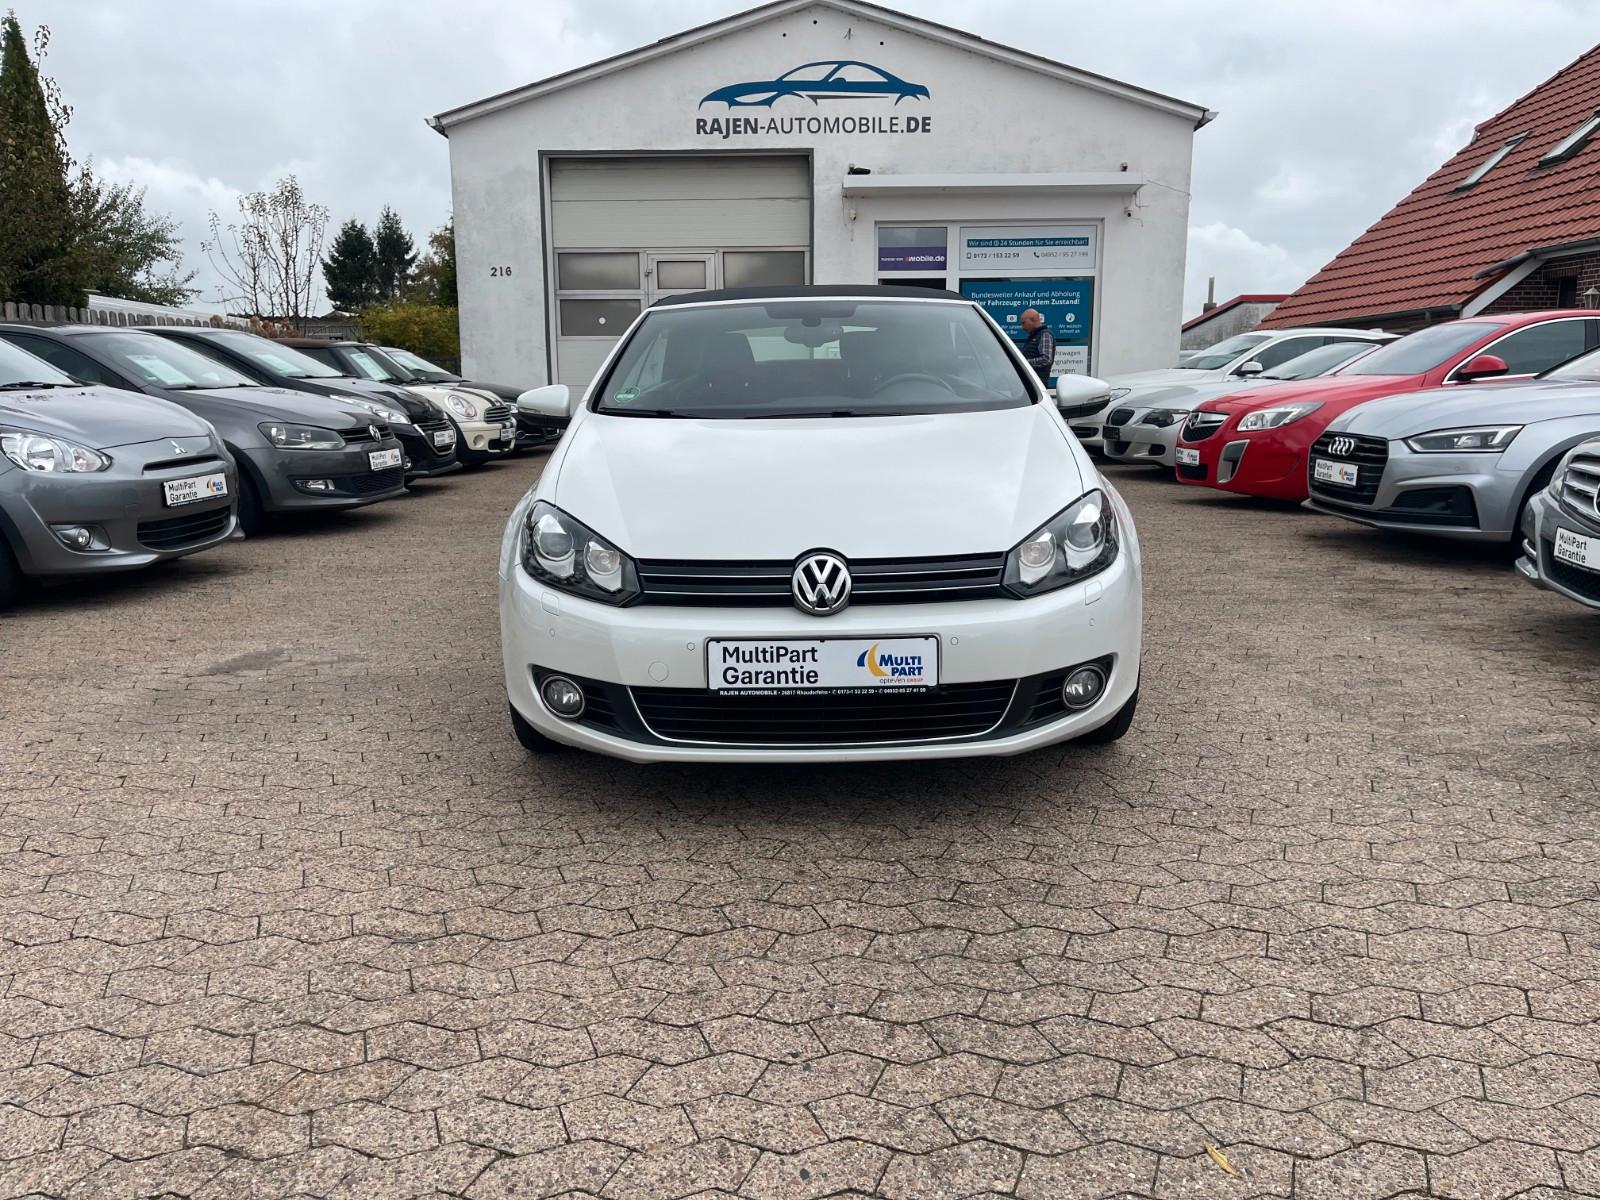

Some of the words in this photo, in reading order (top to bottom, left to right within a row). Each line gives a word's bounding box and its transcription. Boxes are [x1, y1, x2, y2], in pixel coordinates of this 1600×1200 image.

[696, 116, 931, 139] RAJEN-AUTOMOBILE.DE
[490, 266, 512, 277] 216
[1050, 290, 1080, 298] Abholung
[987, 299, 1021, 307] Fahrzeuge
[1029, 299, 1050, 307] jedem
[168, 481, 197, 493] MultiPart
[169, 490, 198, 502] Garantie
[1559, 532, 1587, 551] MultiPart
[1558, 543, 1586, 564] Garantie
[722, 646, 818, 663] MultiPart
[879, 654, 922, 666] MULTI
[722, 666, 818, 685] Garantie
[891, 666, 923, 676] PART
[879, 676, 906, 684] opteven
